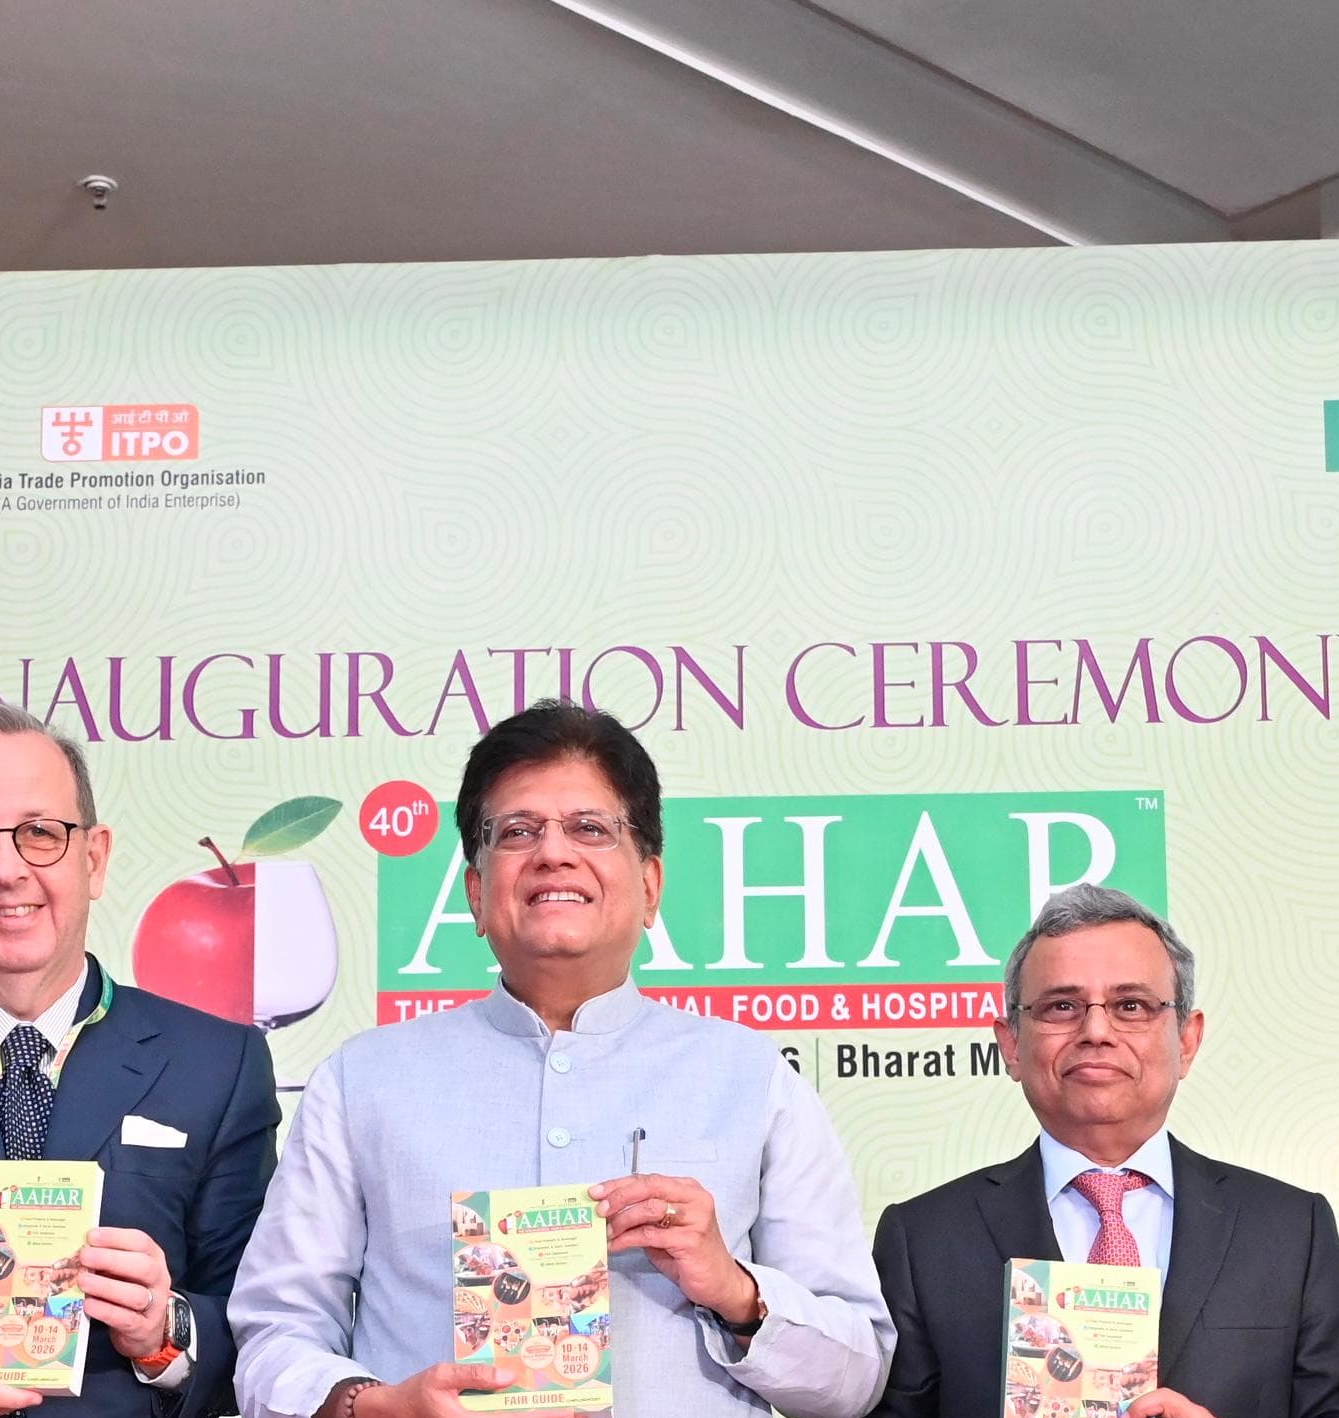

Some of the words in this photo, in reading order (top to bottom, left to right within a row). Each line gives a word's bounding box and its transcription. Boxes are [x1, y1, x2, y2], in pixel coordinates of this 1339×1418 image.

[112, 431, 189, 456] ITPO
[18, 472, 63, 488] Trade
[70, 471, 154, 488] Promotion
[161, 469, 265, 488] Organisation
[16, 495, 104, 511] Government
[107, 494, 121, 509] of
[125, 493, 159, 509] India
[164, 493, 241, 509] Enterprise)
[369, 800, 429, 837] 40th
[398, 811, 1117, 976] HAR
[1136, 798, 1158, 810] TM
[732, 994, 819, 1021] FOOD
[831, 993, 851, 1020] &
[862, 992, 1007, 1020] HOSPITA
[837, 1043, 955, 1078] Bharat
[10, 1188, 82, 1206] AAHAR
[518, 1208, 591, 1230] AAHAR
[1075, 1289, 1148, 1312] AAHAR
[31, 1345, 55, 1354] 2026
[562, 1354, 588, 1362] March
[563, 1363, 589, 1374] 2026
[504, 1395, 528, 1406] FAIR
[532, 1394, 565, 1404] GUIDE
